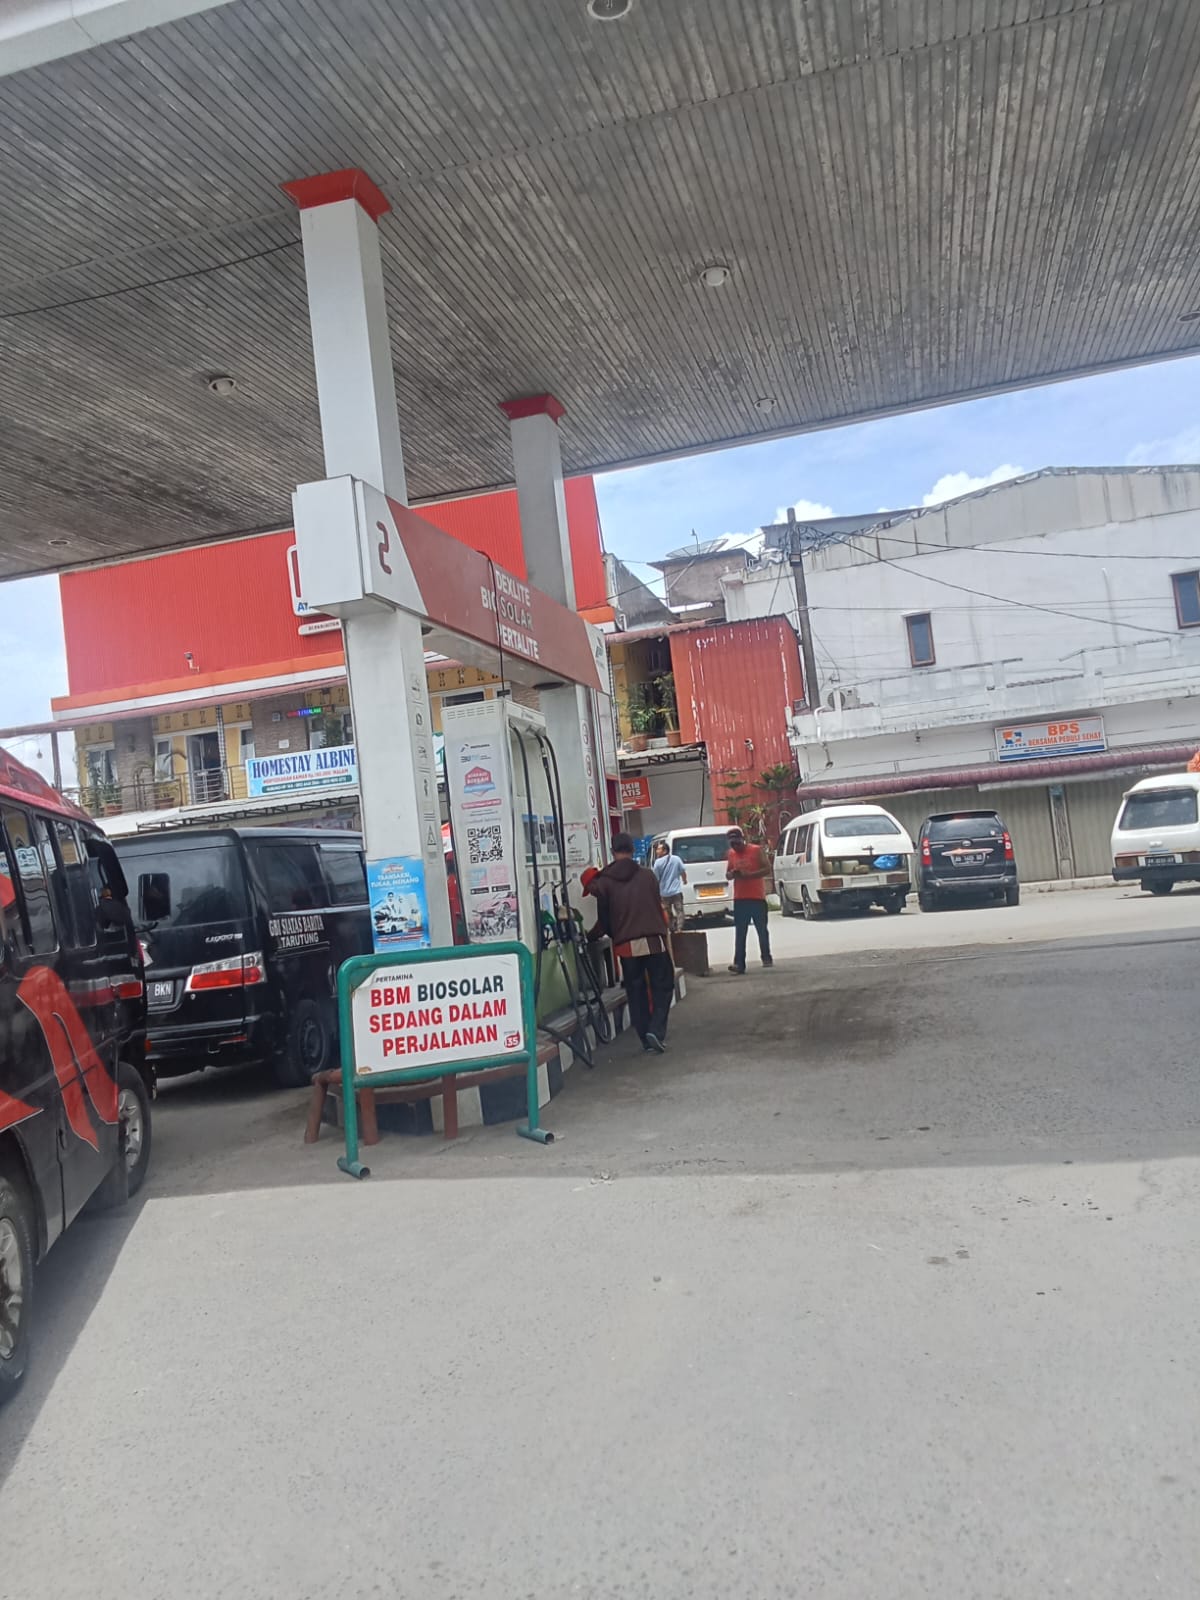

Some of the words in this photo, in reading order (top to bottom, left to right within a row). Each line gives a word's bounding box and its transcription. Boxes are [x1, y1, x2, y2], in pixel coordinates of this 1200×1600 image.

[375, 519, 392, 575] 2
[495, 570, 531, 608] DEXLITE
[297, 602, 311, 612] AT
[500, 596, 534, 631] SOLAR
[1047, 722, 1080, 736] BPS
[252, 754, 312, 779] HOMESTAY
[280, 932, 319, 948] TARUTUNG
[154, 983, 171, 997] BKN
[370, 985, 411, 1008] BBM
[417, 975, 504, 1002] BIOSOLAR
[375, 973, 414, 983] PERTAMINA
[369, 1006, 443, 1034] SEDANG
[448, 998, 507, 1023] DALAM
[382, 1024, 498, 1057] PERJALANAN
